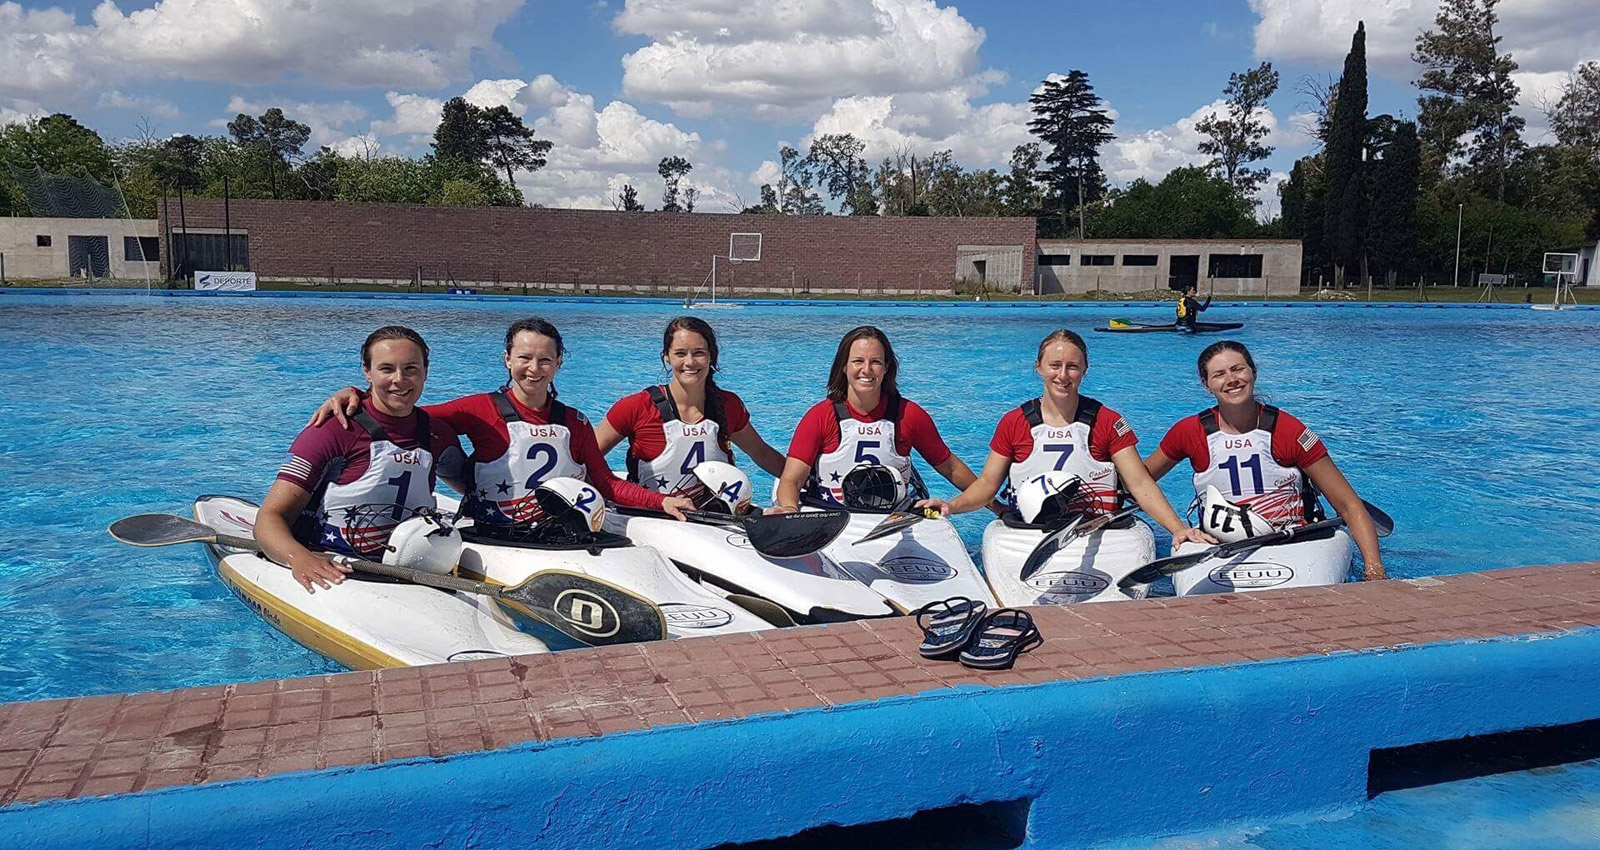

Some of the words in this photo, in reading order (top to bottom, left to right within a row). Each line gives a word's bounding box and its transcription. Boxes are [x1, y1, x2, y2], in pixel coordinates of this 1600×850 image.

[530, 427, 557, 437] USA
[683, 427, 707, 436] USA
[858, 427, 881, 435] USA
[1047, 430, 1072, 438] USA
[854, 440, 881, 468] 5
[1225, 439, 1252, 449] USA
[393, 453, 420, 465] USA
[525, 443, 558, 489] 2
[680, 441, 705, 474] 4
[1043, 444, 1074, 471] 7
[1031, 475, 1049, 495] 7
[1218, 454, 1264, 496] 11
[388, 470, 412, 521] 1
[575, 487, 596, 514] 2
[722, 480, 743, 503] 4
[1219, 570, 1282, 579] EEUU
